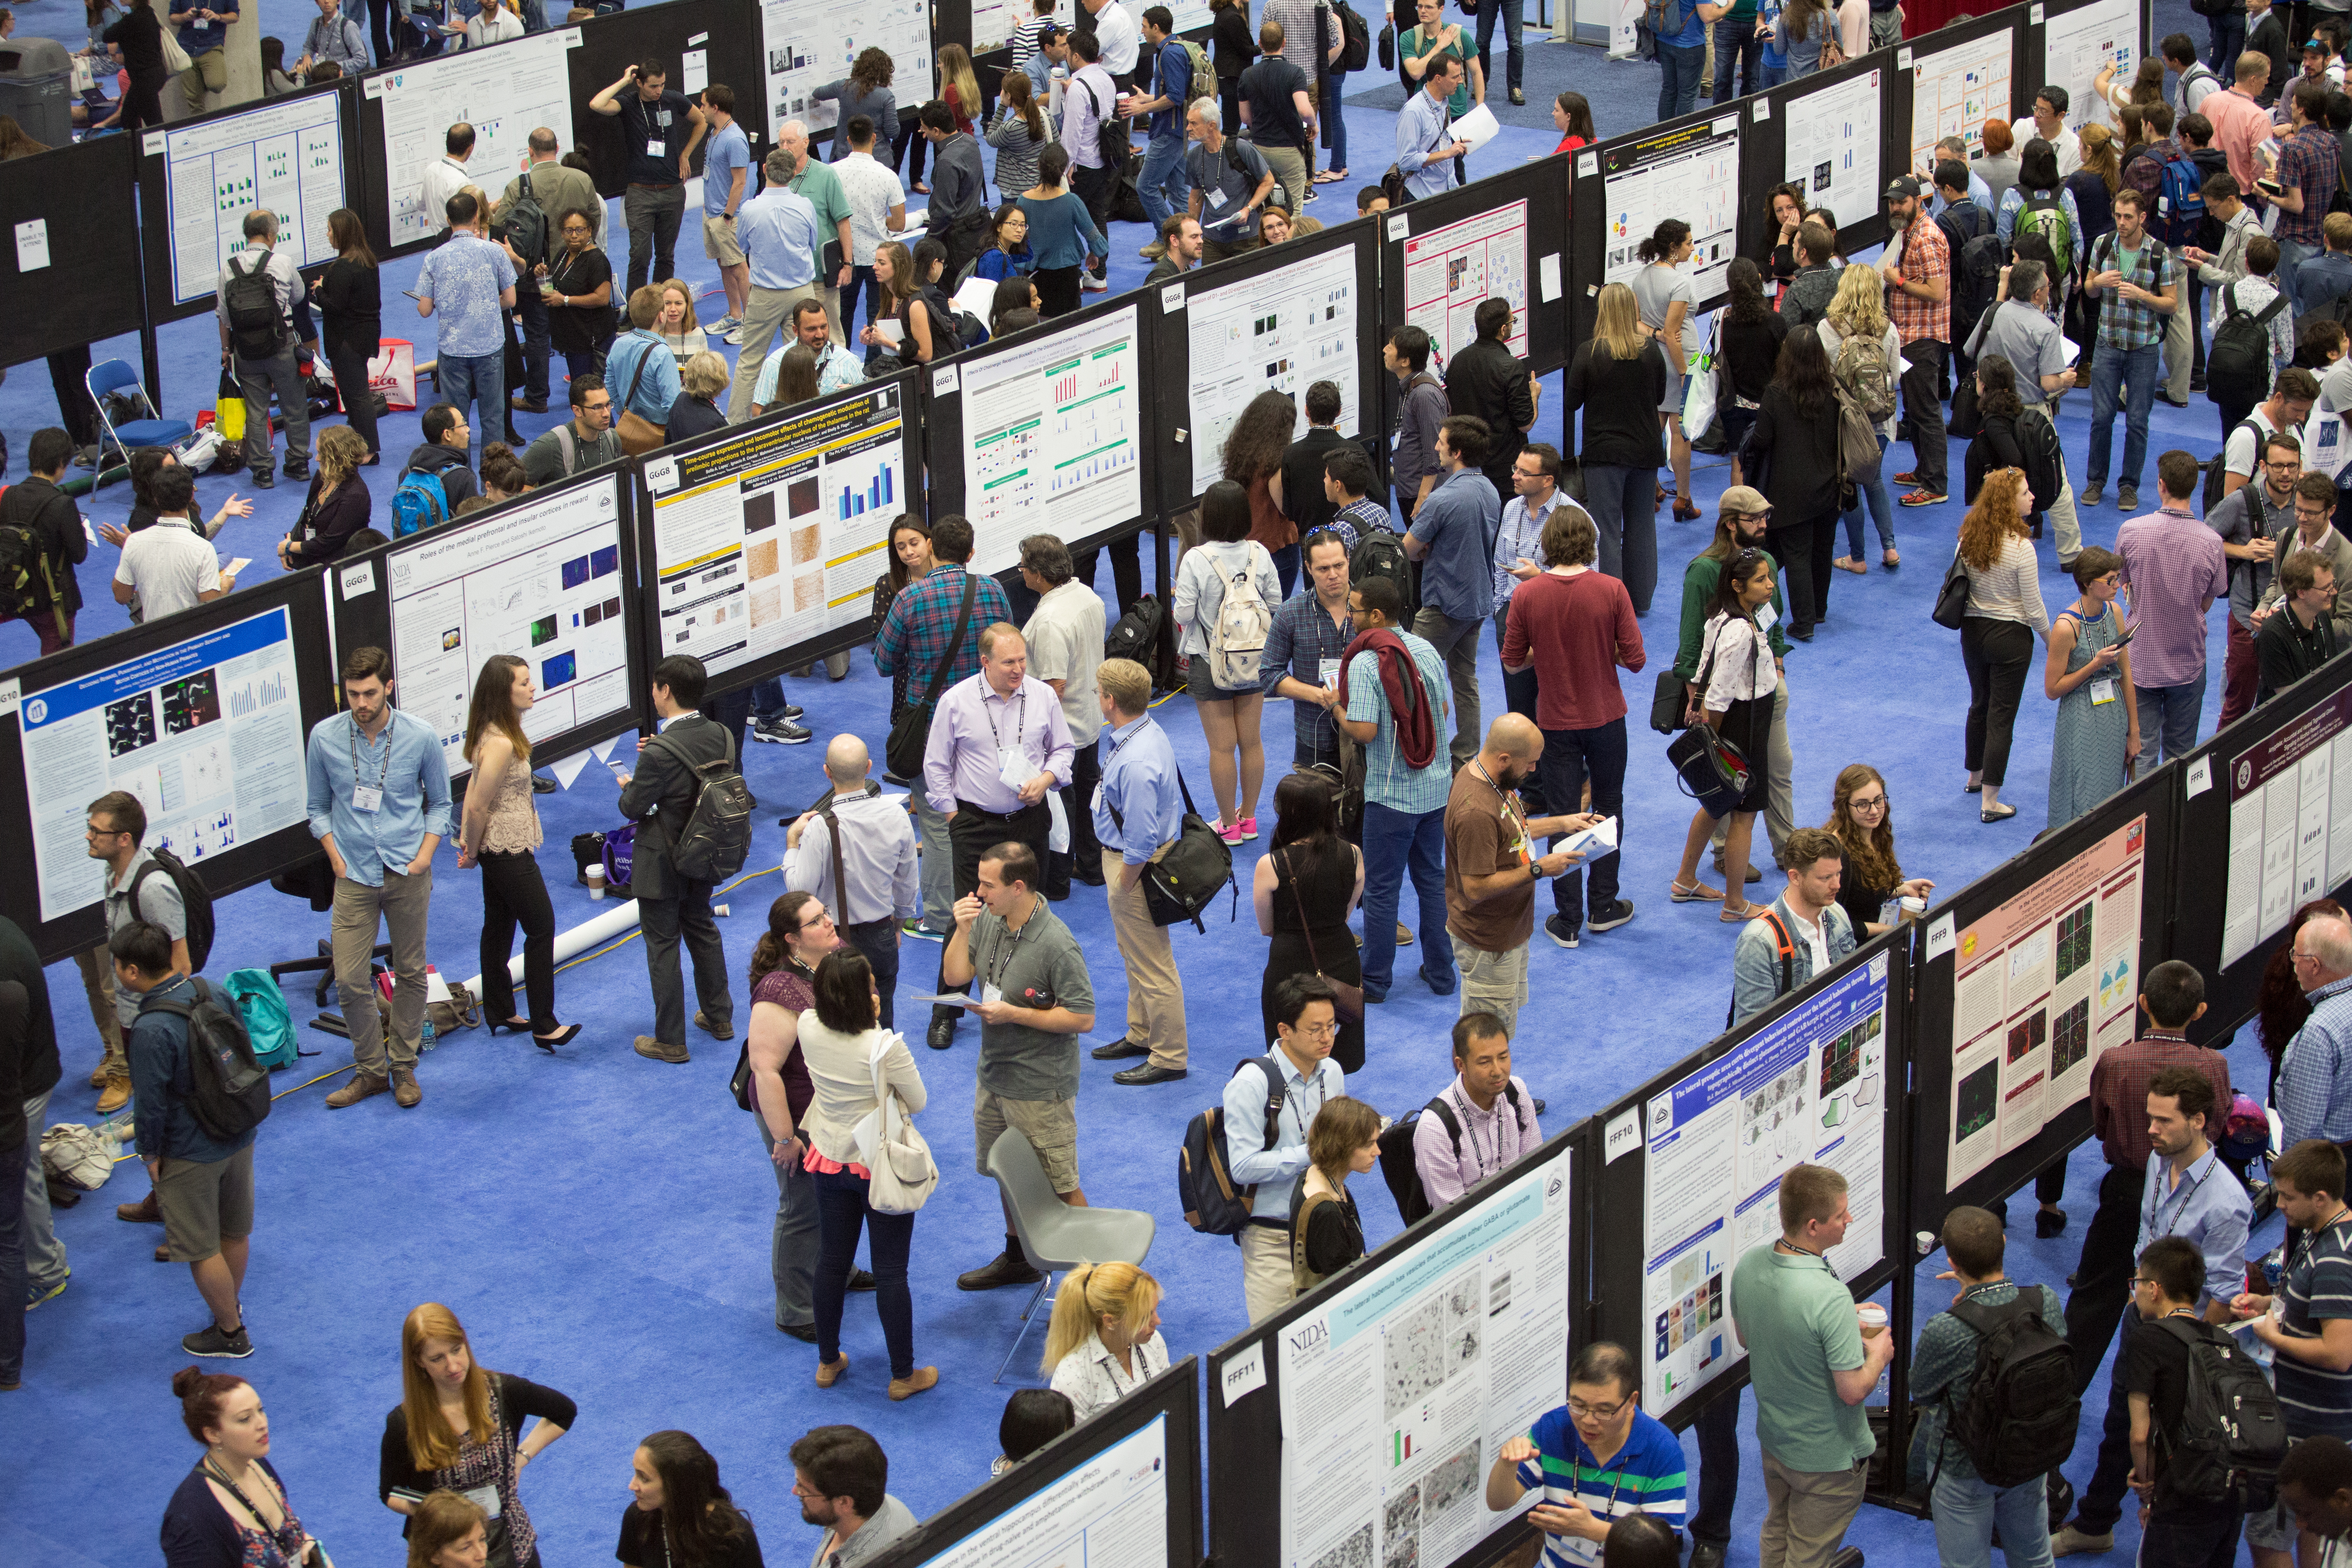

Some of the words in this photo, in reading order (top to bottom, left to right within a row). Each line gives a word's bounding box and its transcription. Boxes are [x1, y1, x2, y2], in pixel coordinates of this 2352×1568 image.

[450, 60, 467, 69] neuronal
[1663, 132, 1686, 141] amygdala-insular
[1580, 160, 1593, 169] GGG4
[1390, 223, 1404, 232] GGG5
[19, 234, 36, 242] UNABLE
[23, 239, 41, 247] ATTEND
[1428, 236, 1441, 245] Dynamic
[1188, 298, 1206, 306] Activation
[1228, 282, 1255, 293] D2-expressing
[1296, 261, 1317, 271] accumbens
[1318, 255, 1334, 263] enhances
[1335, 249, 1353, 257] motivation
[1165, 293, 1180, 303] GGG6
[983, 361, 1001, 370] Cholinergic
[1043, 340, 1062, 350] Orbitofrontal
[936, 375, 952, 386] GGG7
[684, 451, 715, 465] Time-course
[716, 441, 743, 454] expression
[744, 437, 754, 445] and
[755, 430, 779, 441] locomotor
[780, 423, 796, 433] effects
[804, 409, 836, 425] chemogenetic
[837, 401, 863, 413] modulation
[686, 461, 710, 474] prelimbic
[711, 452, 739, 466] projections
[755, 434, 791, 452] paraventricular
[792, 428, 811, 437] nucleus
[826, 415, 848, 426] thalamus
[649, 467, 670, 479] GGG8
[684, 486, 710, 497] Introduction
[420, 550, 437, 560] Roles
[456, 535, 476, 547] medial
[477, 524, 505, 541] prefrontal
[506, 520, 517, 529] and
[518, 514, 538, 525] insular
[539, 506, 561, 517] cortices
[569, 494, 588, 506] reward
[857, 546, 877, 555] Summary
[693, 555, 710, 564] Methods
[392, 563, 410, 579] NIDA
[346, 575, 367, 588] GGG9
[2191, 770, 2203, 783] FFF8
[2000, 889, 2029, 911] Neurochemical
[2030, 877, 2050, 893] phenotype
[2056, 858, 2079, 876] cannabinoid
[2088, 842, 2105, 855] receptors
[2031, 889, 2044, 902] ventral
[2045, 876, 2064, 893] tegmental
[2079, 862, 2088, 871] mice
[1931, 928, 1946, 944] FFF9
[1676, 1090, 1685, 1099] The
[1686, 1078, 1700, 1094] lateral
[1701, 1068, 1720, 1085] preoptic
[1721, 1061, 1731, 1071] area
[1731, 1053, 1743, 1065] exerts
[1744, 1039, 1764, 1057] divergent
[1765, 1024, 1786, 1044] behavioral
[1787, 1014, 1802, 1029] control
[1802, 1009, 1811, 1019] over
[1819, 993, 1832, 1008] lateral
[1833, 982, 1851, 998] habenula
[1851, 971, 1866, 987] through
[1708, 1067, 1742, 1093] topographically
[1743, 1055, 1758, 1069] distinct
[1759, 1037, 1786, 1060] glutamatergic
[1796, 1015, 1819, 1033] GABAergic
[1820, 1000, 1841, 1019] projections
[1610, 1124, 1633, 1145] FFF10
[1343, 1307, 1353, 1316] The
[1354, 1294, 1370, 1310] lateral
[1371, 1281, 1394, 1299] habenula
[1396, 1274, 1405, 1283] has
[1406, 1260, 1425, 1276] vesicles
[1427, 1252, 1436, 1263] that
[1437, 1234, 1466, 1256] accumulate
[1468, 1223, 1482, 1236] either
[1483, 1212, 1499, 1226] GABA
[1506, 1195, 1530, 1214] glutamate
[1290, 1320, 1329, 1356] NIDA
[1228, 1361, 1255, 1386] FFF11
